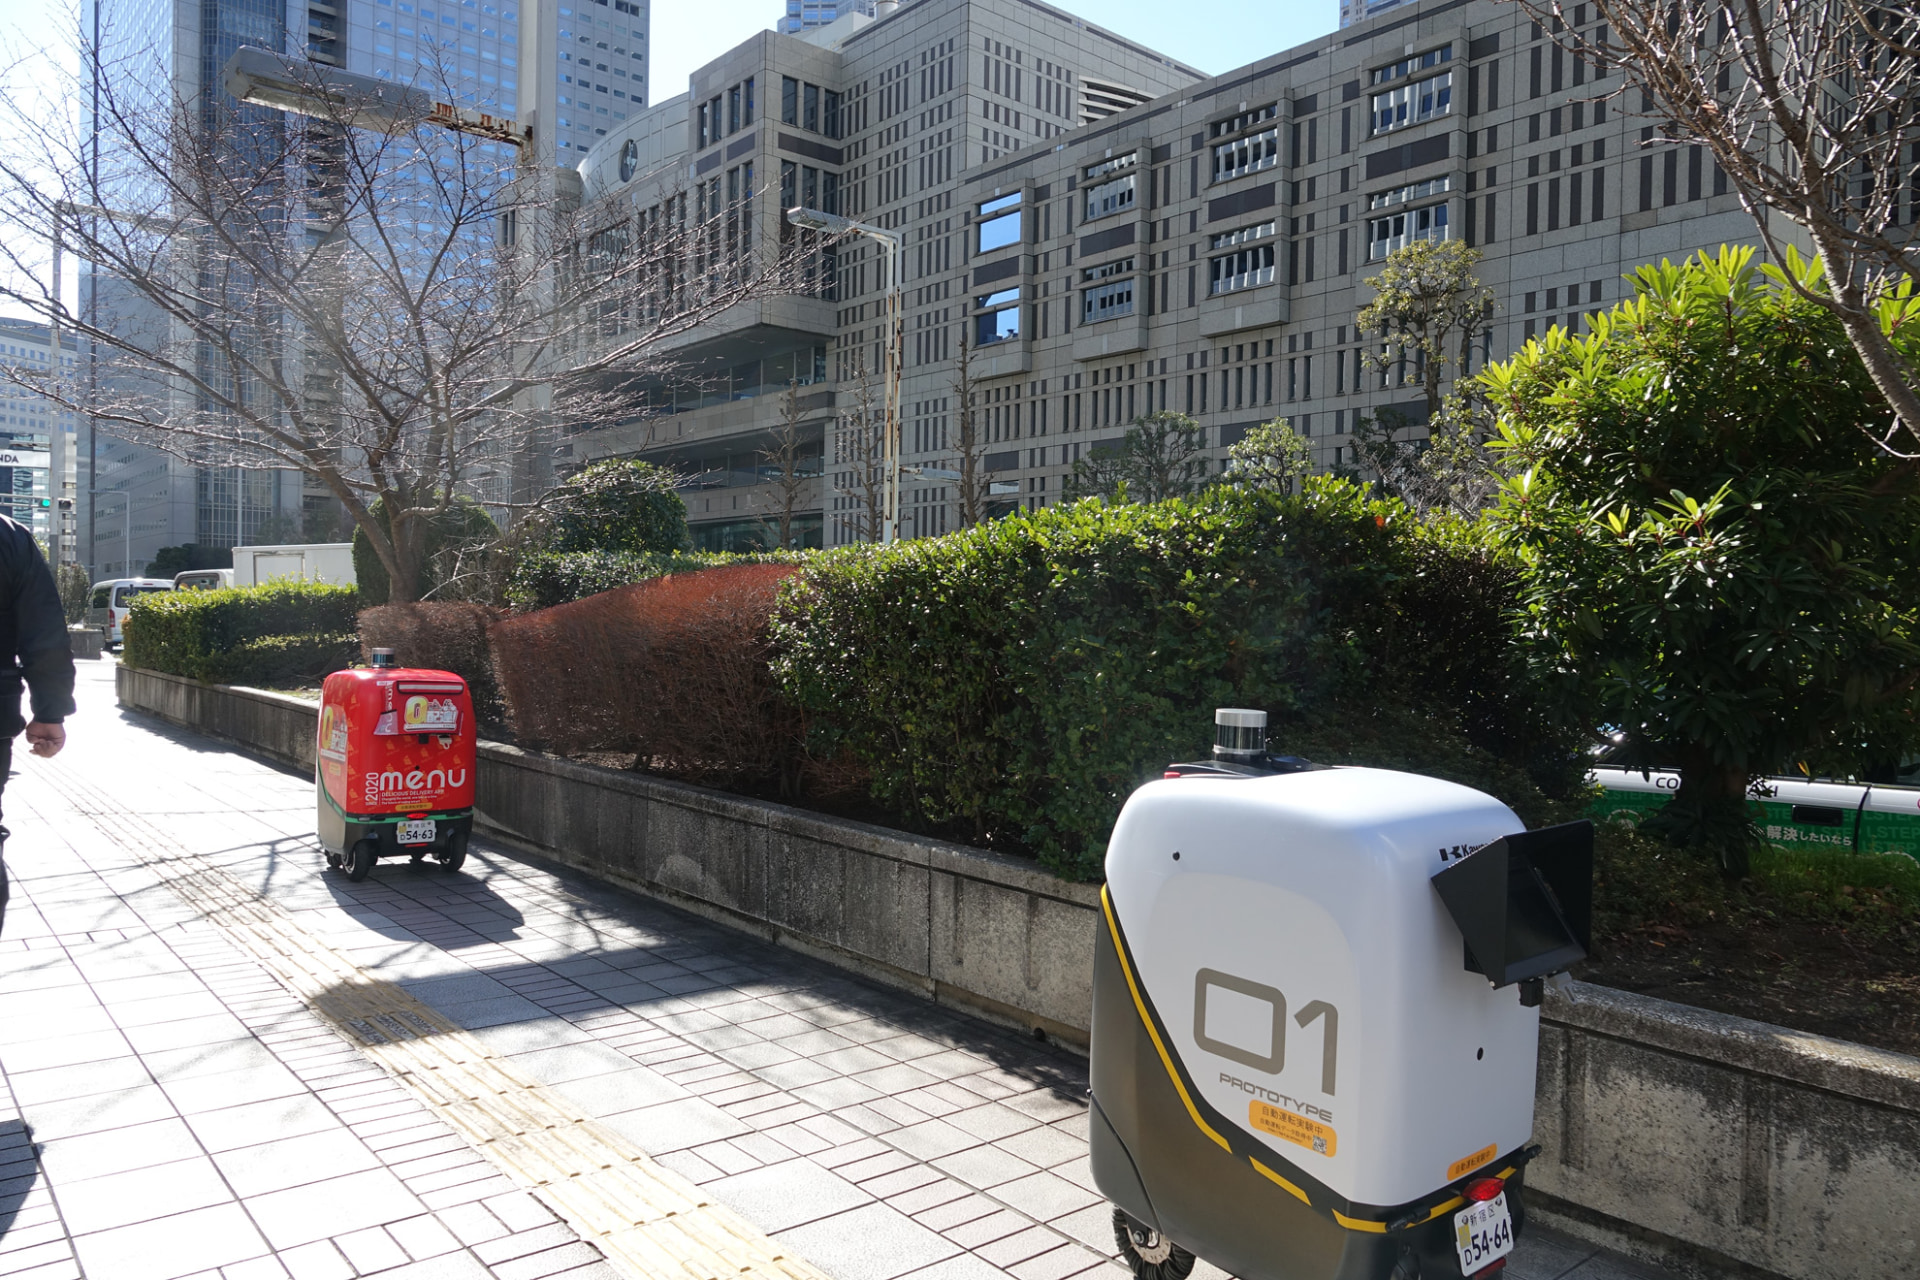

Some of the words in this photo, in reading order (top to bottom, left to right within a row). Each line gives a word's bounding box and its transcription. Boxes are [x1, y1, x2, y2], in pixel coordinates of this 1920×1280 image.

[365, 772, 379, 802] 2020
[380, 769, 466, 791] menu
[406, 829, 433, 840] 54-63
[1766, 825, 1852, 846] 解決したいなら
[1193, 967, 1338, 1096] 01
[1219, 1072, 1332, 1123] PROTOTYPE
[1262, 1106, 1323, 1135] 自動運転実験中
[1470, 1204, 1495, 1225] 新宿区
[1464, 1249, 1473, 1266] D
[1471, 1218, 1509, 1260] 54-64
